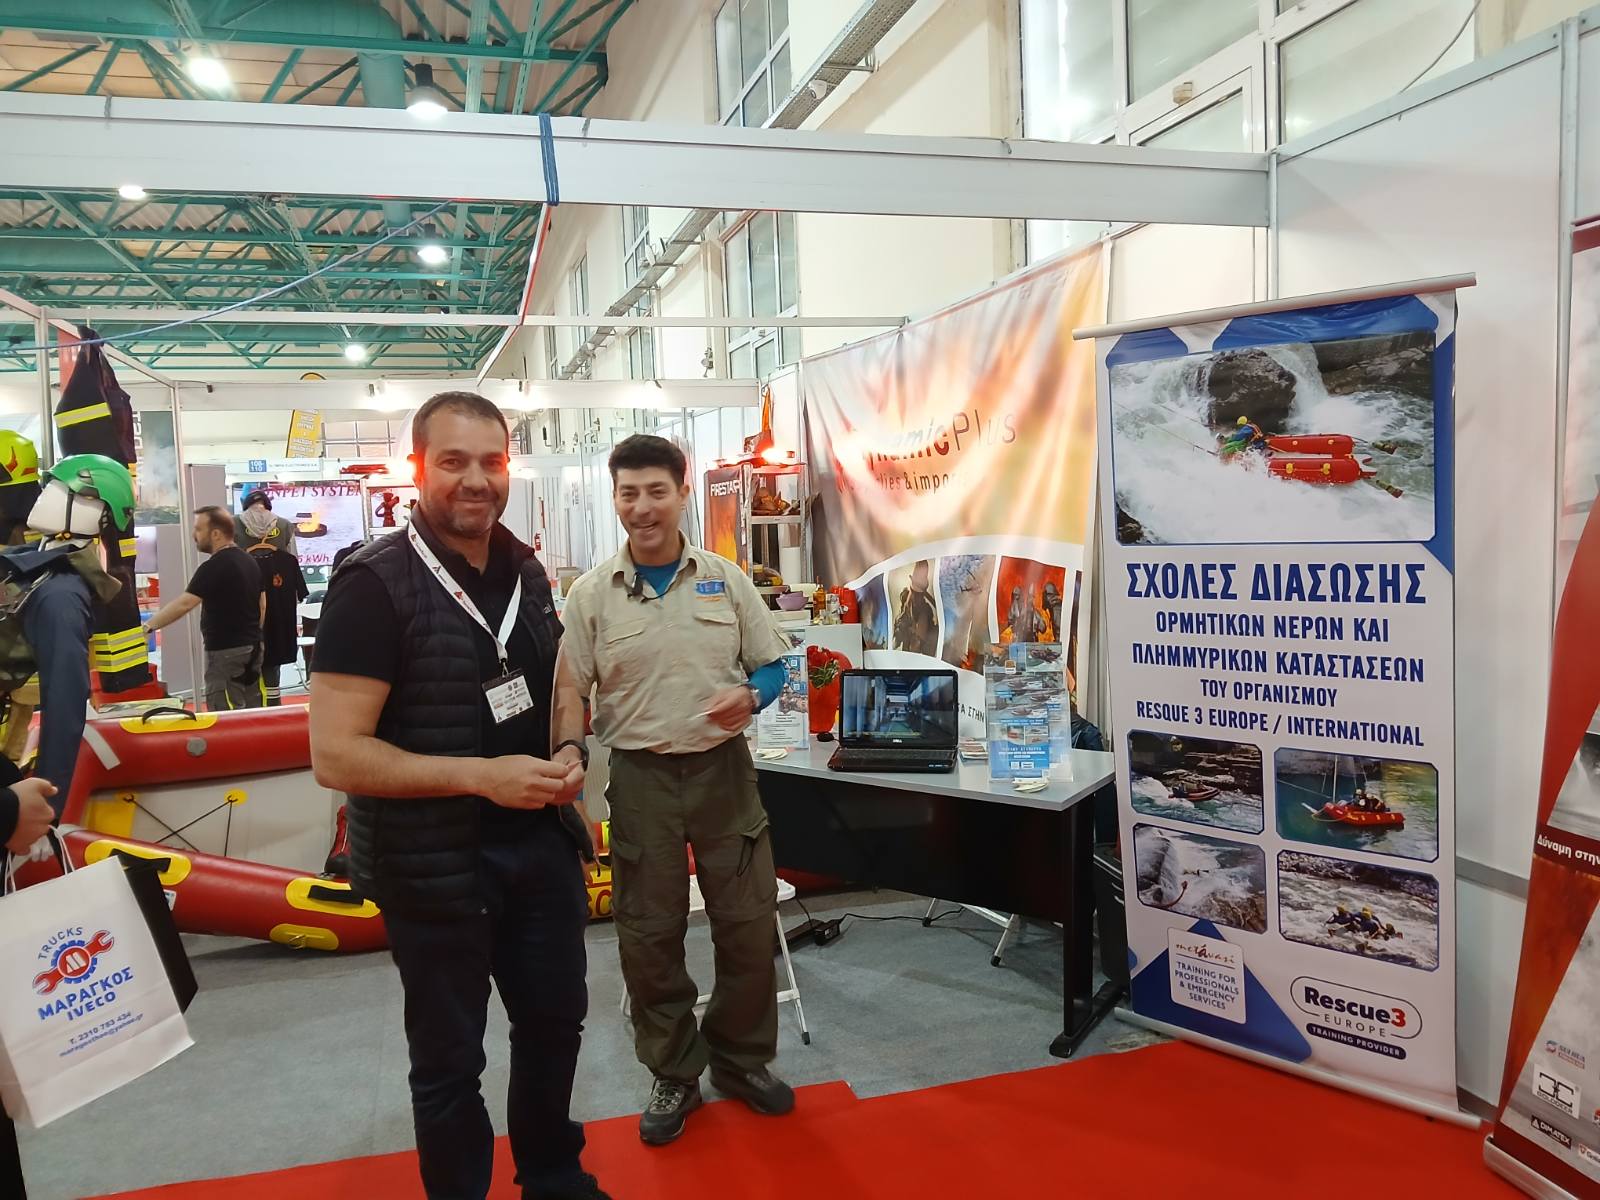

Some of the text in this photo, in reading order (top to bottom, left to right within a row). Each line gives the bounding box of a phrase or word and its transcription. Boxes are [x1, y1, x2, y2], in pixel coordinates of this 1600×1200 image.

[1126, 562, 1426, 604] ΣΧΟΛΕΣ ΔΙΑΣΩΣΗΣ
[1156, 611, 1389, 642] ΟΡΜΗΤΙΚΩΝ ΝΕΡΩΝ ΚΑΙ
[1132, 643, 1424, 682] ΠΛΗΜΜΥΡΙΚΩΝ ΚΑΤΑΣΤΑΣΕΩΝ
[1200, 679, 1337, 707] ΤΟΥ ΟΡΓΑΝΙΣΜΟΥ
[1136, 700, 1424, 747] RESQUE 3 EUROPE / INTERNATIONAL
[1537, 834, 1572, 858] Δύναμη
[38, 926, 84, 960] TRUCKS
[1175, 970, 1239, 995] PROFESSIONALS
[1177, 962, 1236, 984] TRAINING FOR
[38, 966, 134, 1020] ΜΑΡΑΓΚΟΣ
[67, 991, 117, 1021] IVECO
[1188, 982, 1235, 1003] EMERGENCY
[1189, 993, 1226, 1010] SERVICES
[1304, 986, 1407, 1028] Rescue3
[1324, 1013, 1387, 1038] EUROPE
[1312, 1026, 1400, 1057] TRAINING PROVIDER
[1540, 1121, 1570, 1145] DIMATEX
